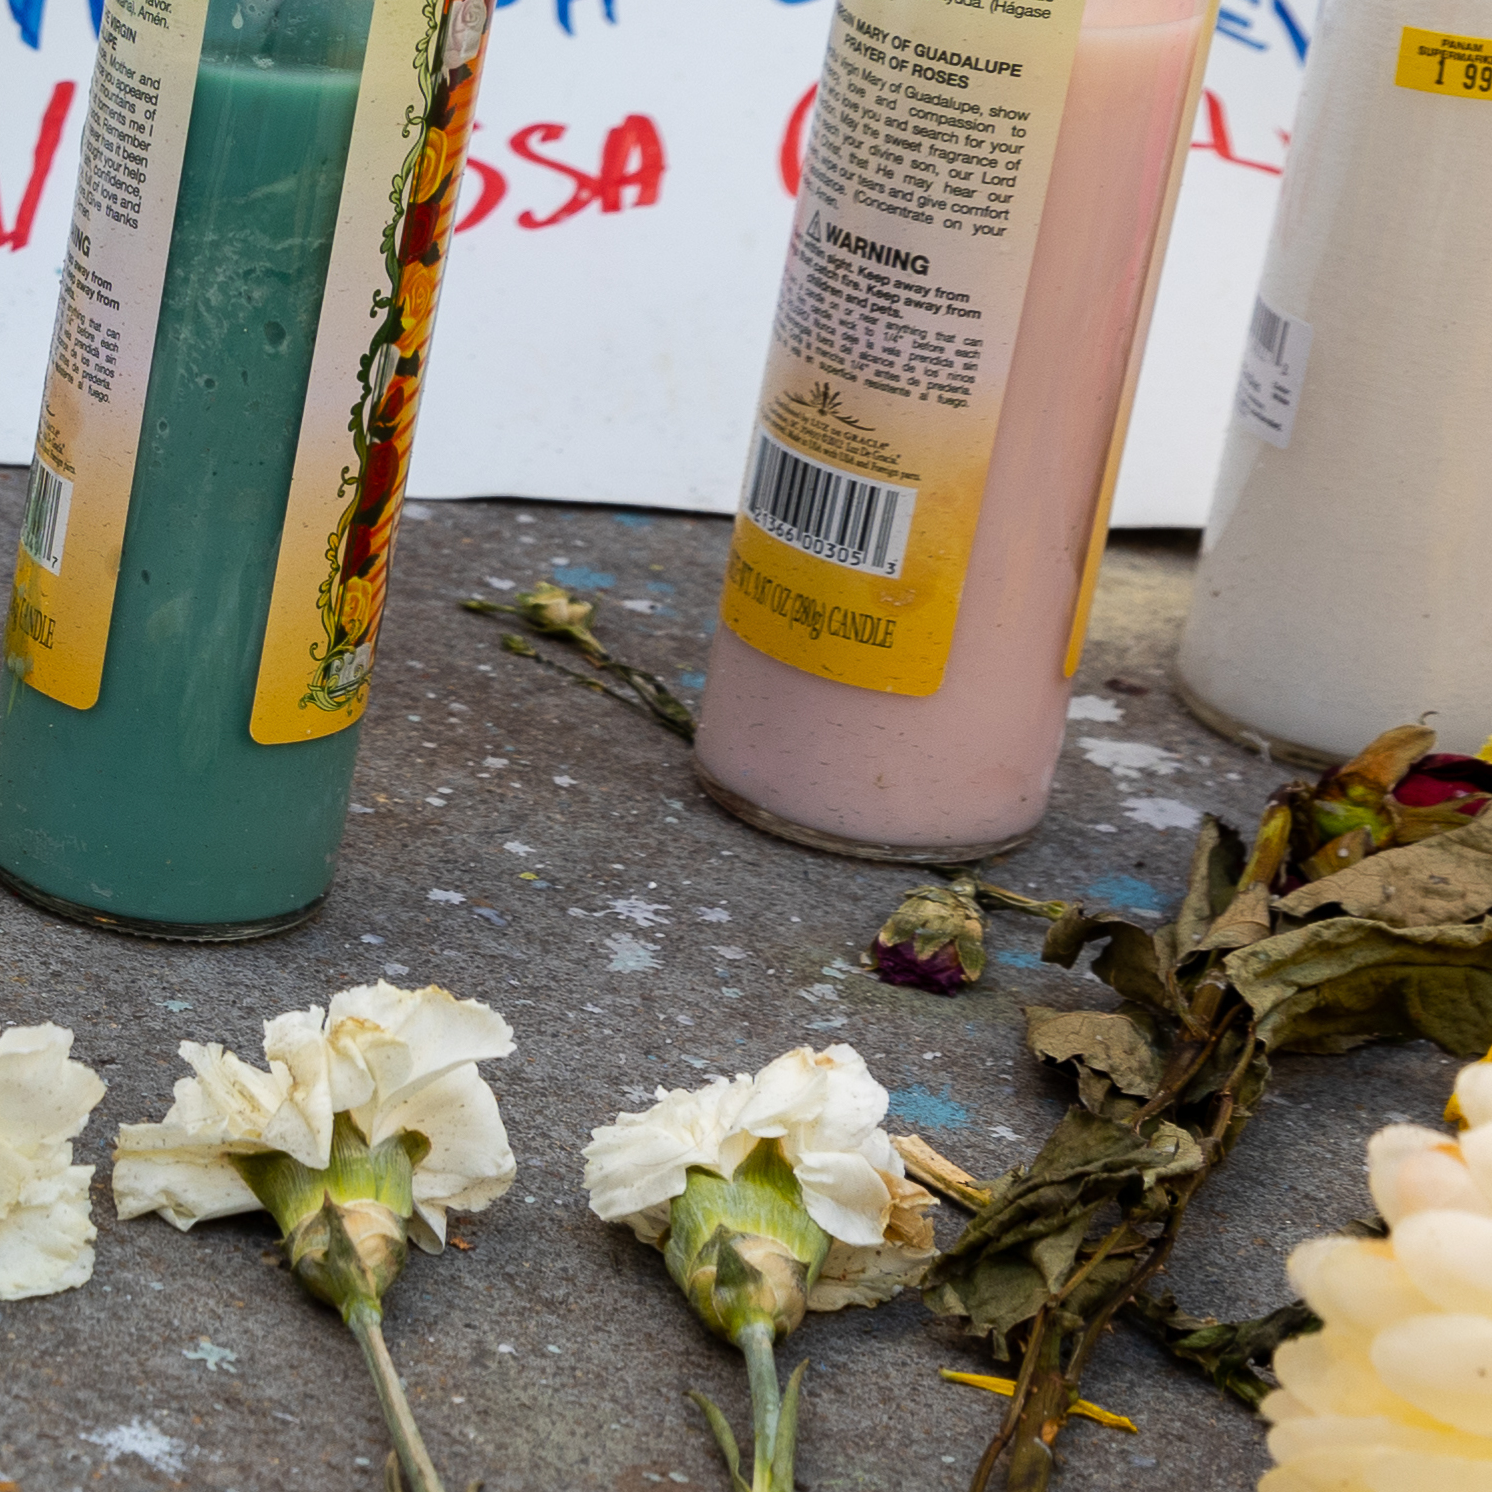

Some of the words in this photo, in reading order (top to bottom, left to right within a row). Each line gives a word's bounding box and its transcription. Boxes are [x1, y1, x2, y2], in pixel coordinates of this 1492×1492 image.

[891, 35, 912, 52] OF
[913, 43, 1023, 78] GUADALUPE
[138, 74, 161, 91] and
[888, 55, 910, 72] OF
[910, 63, 969, 89] ROSES
[1462, 63, 1492, 93] 99
[903, 85, 983, 120] Guadalupe,
[988, 105, 1031, 121] show
[907, 106, 995, 134] compassion
[1010, 125, 1027, 138] to
[911, 124, 959, 144] search
[964, 133, 986, 149] for
[988, 141, 1025, 154] your
[121, 145, 148, 168] been
[927, 143, 999, 169] fragrance
[1004, 158, 1022, 171] of
[122, 162, 146, 185] help
[947, 168, 975, 181] our
[980, 171, 1017, 188] Lord
[942, 181, 978, 199] hear
[986, 191, 1014, 204] our
[950, 202, 1010, 221] comfort
[971, 223, 1008, 237] your
[826, 222, 930, 276] WARNING
[892, 279, 932, 298] away
[934, 286, 970, 303] from
[902, 296, 942, 315] away
[944, 303, 982, 319] from
[801, 531, 863, 567] 00305
[885, 559, 898, 575] 3
[826, 605, 896, 649] CANDLE
